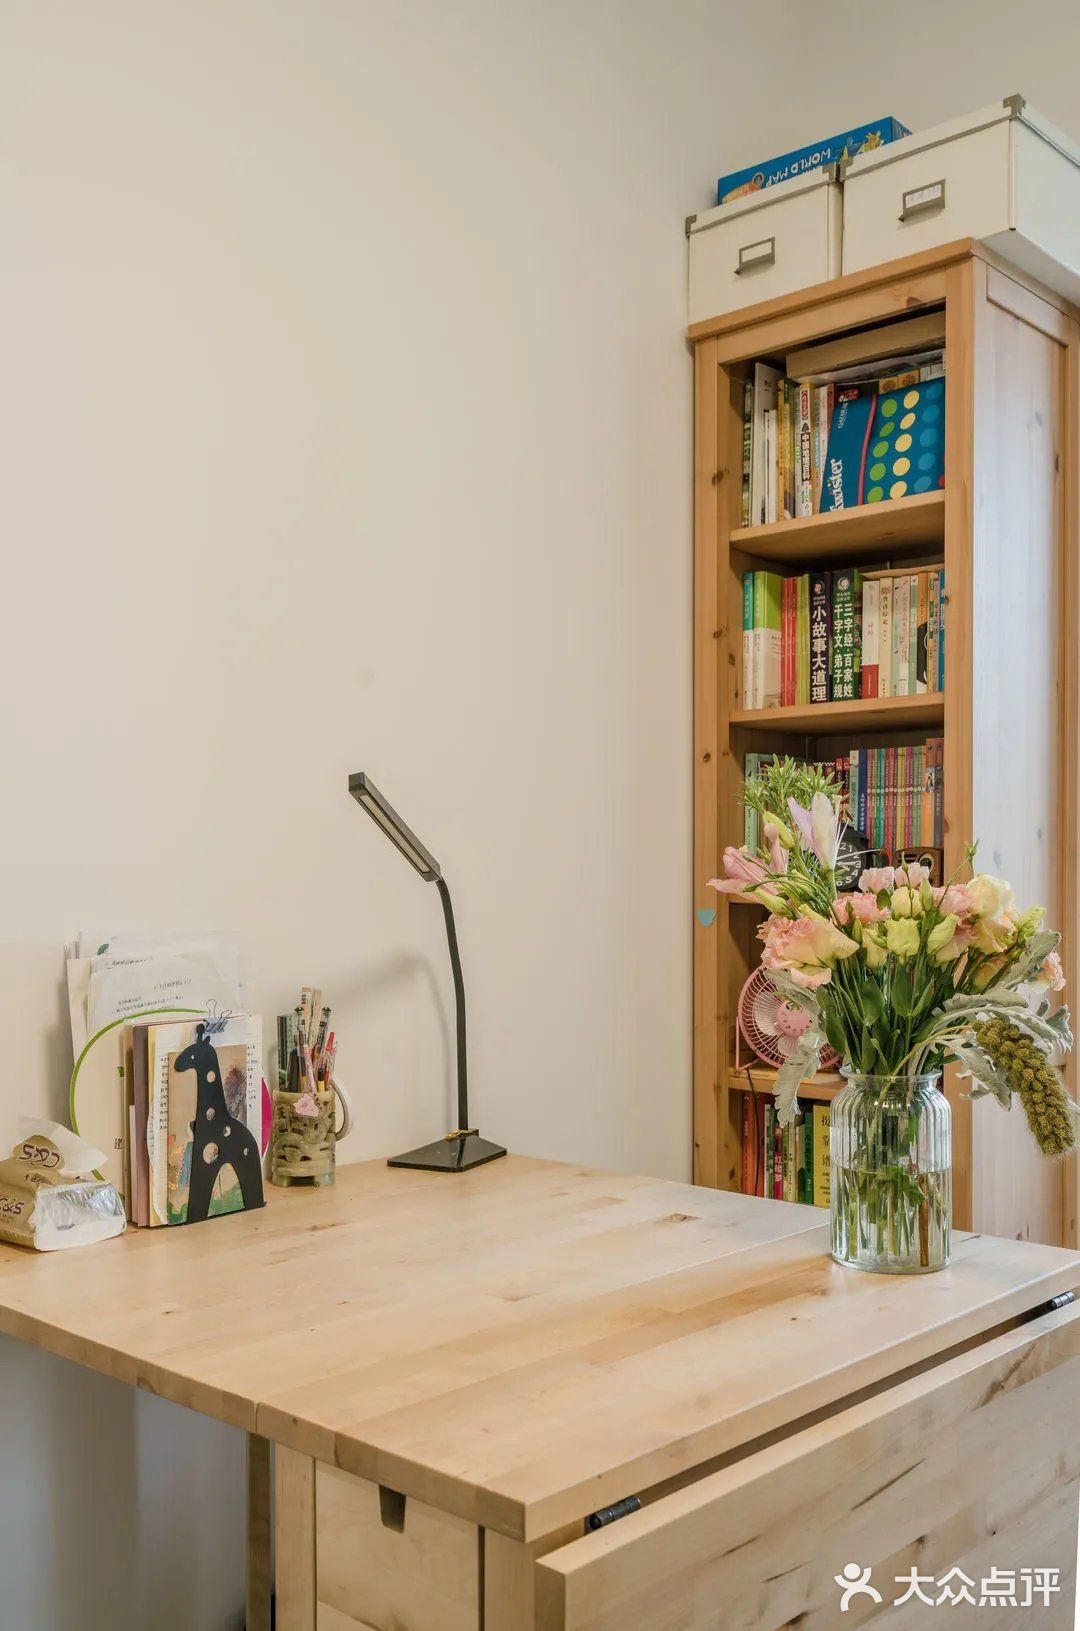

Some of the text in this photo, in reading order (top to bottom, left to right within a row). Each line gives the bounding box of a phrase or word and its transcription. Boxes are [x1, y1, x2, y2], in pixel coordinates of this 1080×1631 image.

[765, 147, 831, 187] WORLD MAP
[812, 605, 827, 702] 小故事大道理
[833, 604, 843, 698] 千字文·弟子规
[843, 603, 854, 697] 三字经·百家姓
[845, 876, 853, 884] 5
[851, 869, 859, 877] 4
[19, 1144, 61, 1168] C&S
